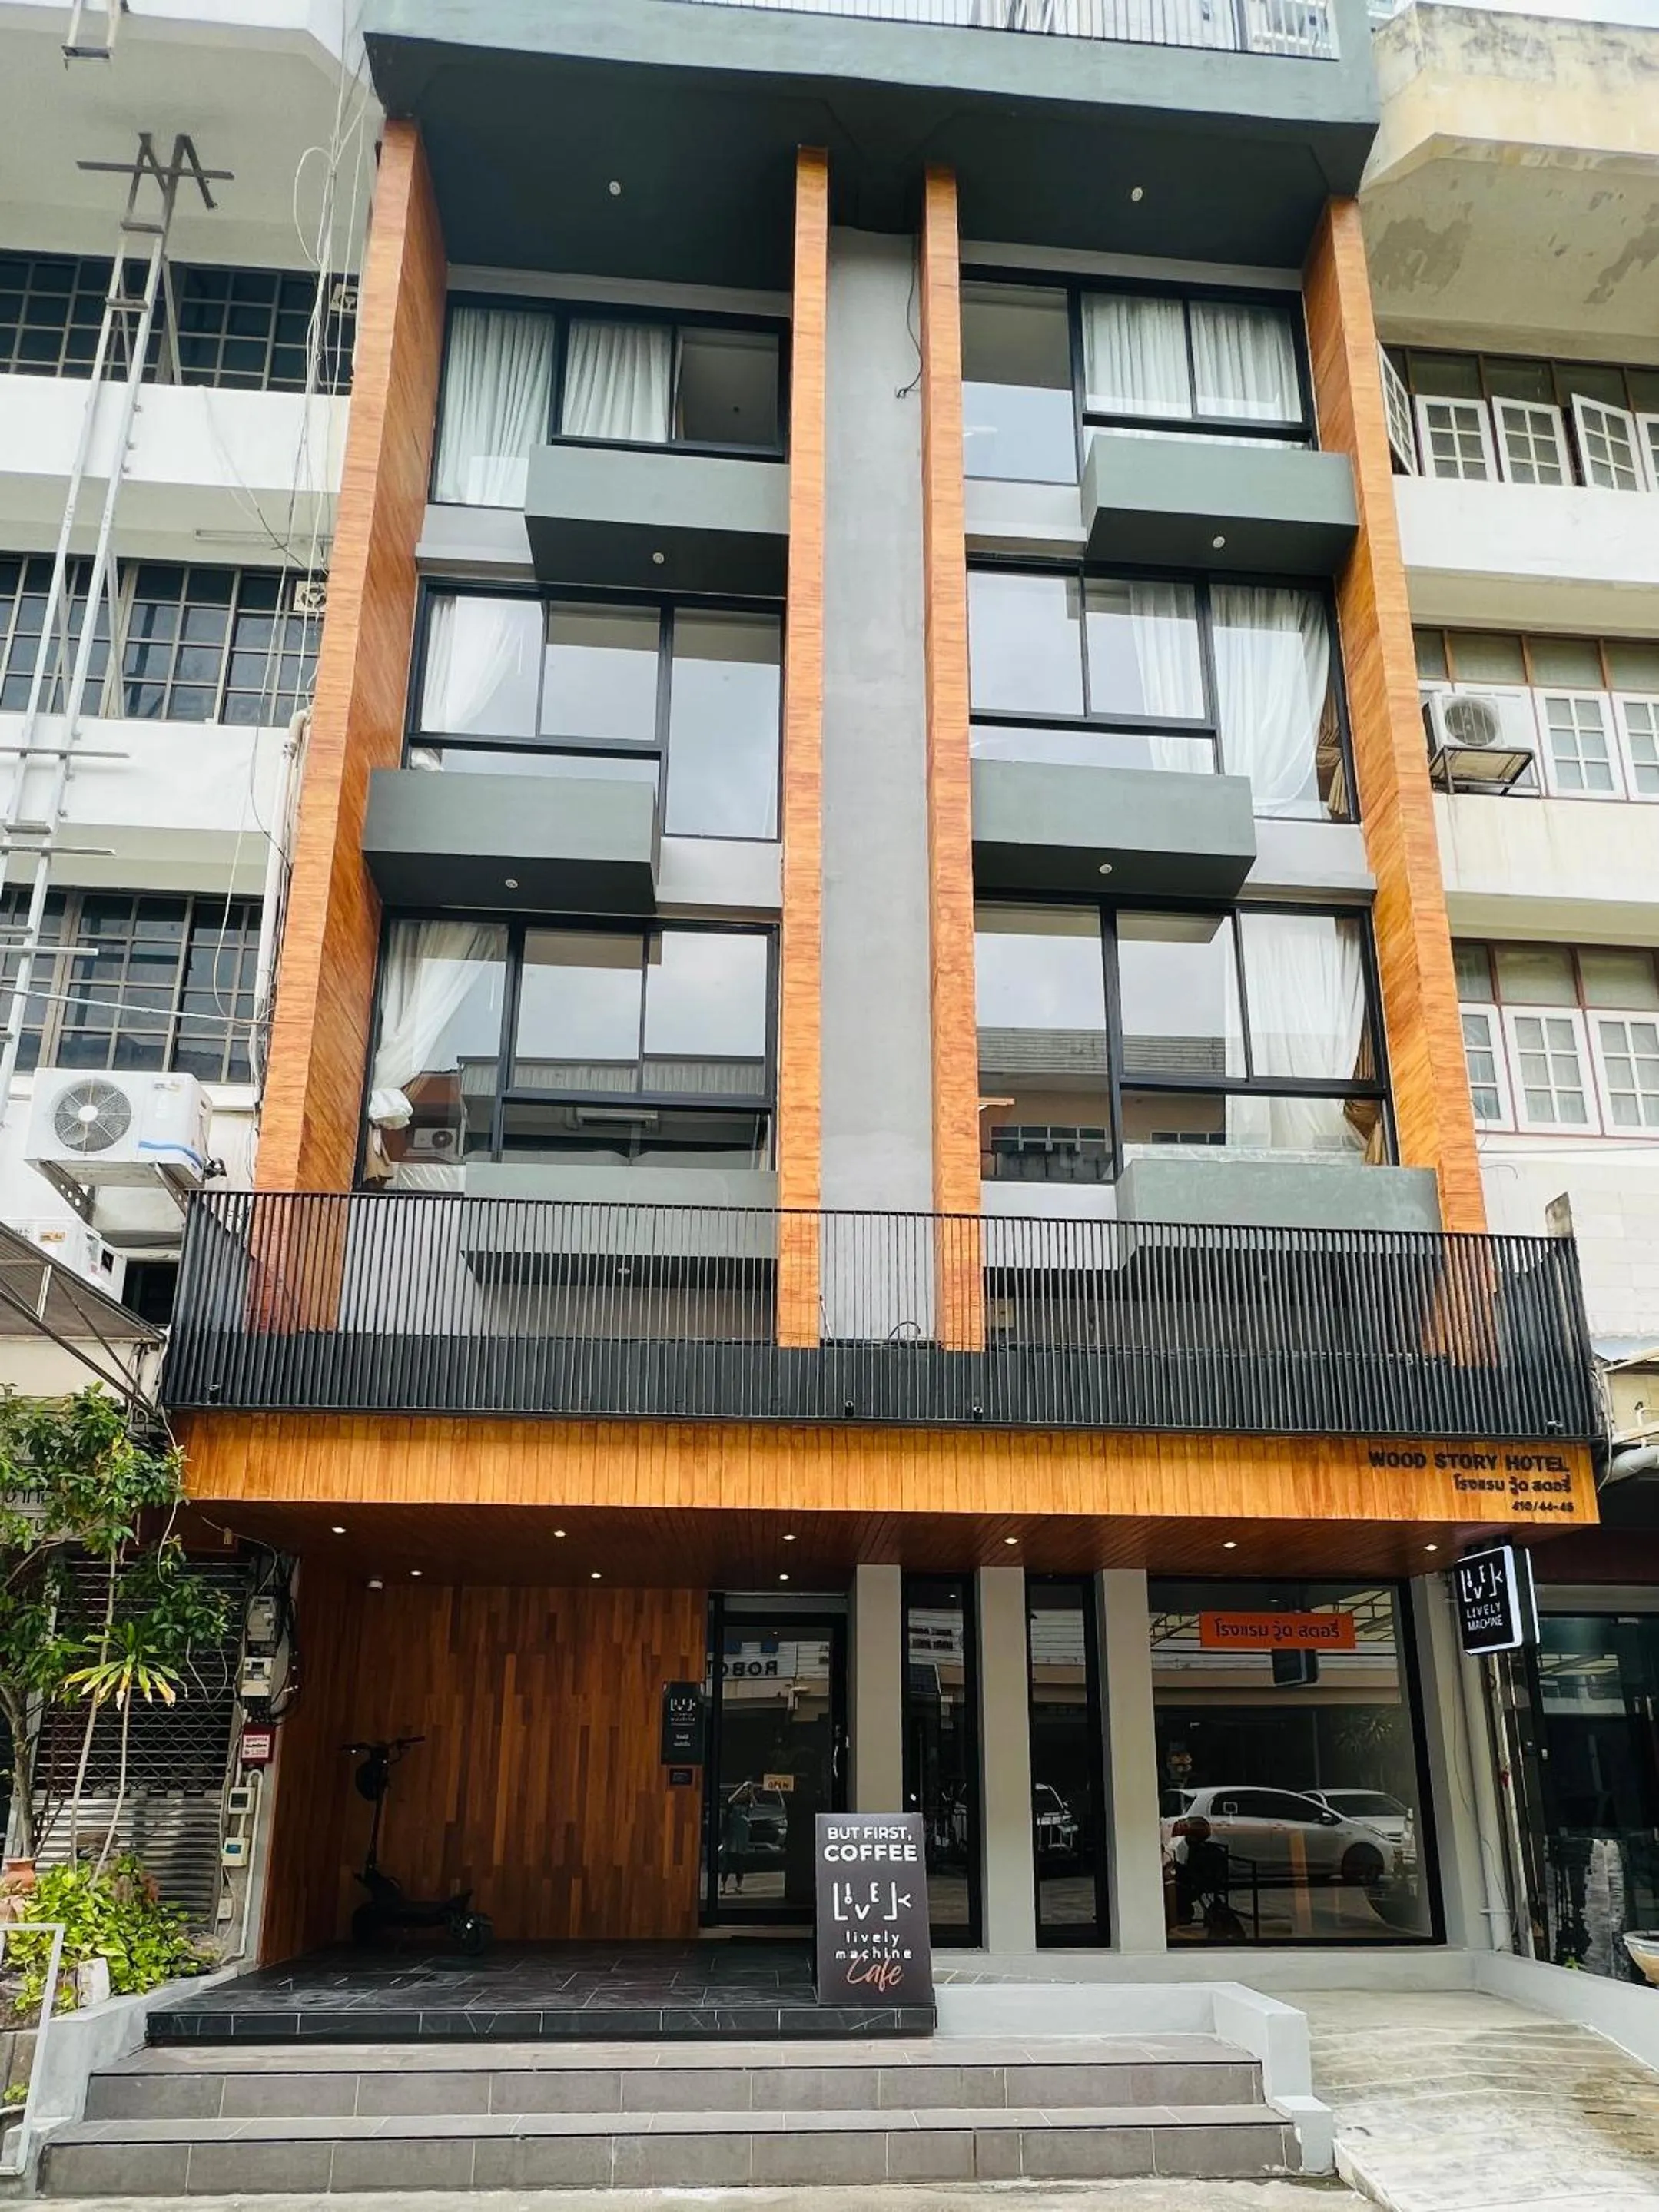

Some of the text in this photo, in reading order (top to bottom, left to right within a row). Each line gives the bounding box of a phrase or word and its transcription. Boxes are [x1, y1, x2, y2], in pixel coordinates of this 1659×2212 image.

[1369, 1450, 1571, 1472] WOOD STORY HOTEL
[1454, 1473, 1505, 1491] โรงแรม
[1466, 1601, 1501, 1619] LIVELY
[1214, 1617, 1269, 1638] โรงแรม
[1468, 1614, 1504, 1632] MACHINE
[827, 1826, 912, 1842] BUT FIRST,
[824, 1844, 917, 1862] COFFEE
[846, 1930, 900, 1948] lively
[835, 1948, 912, 1961] machine
